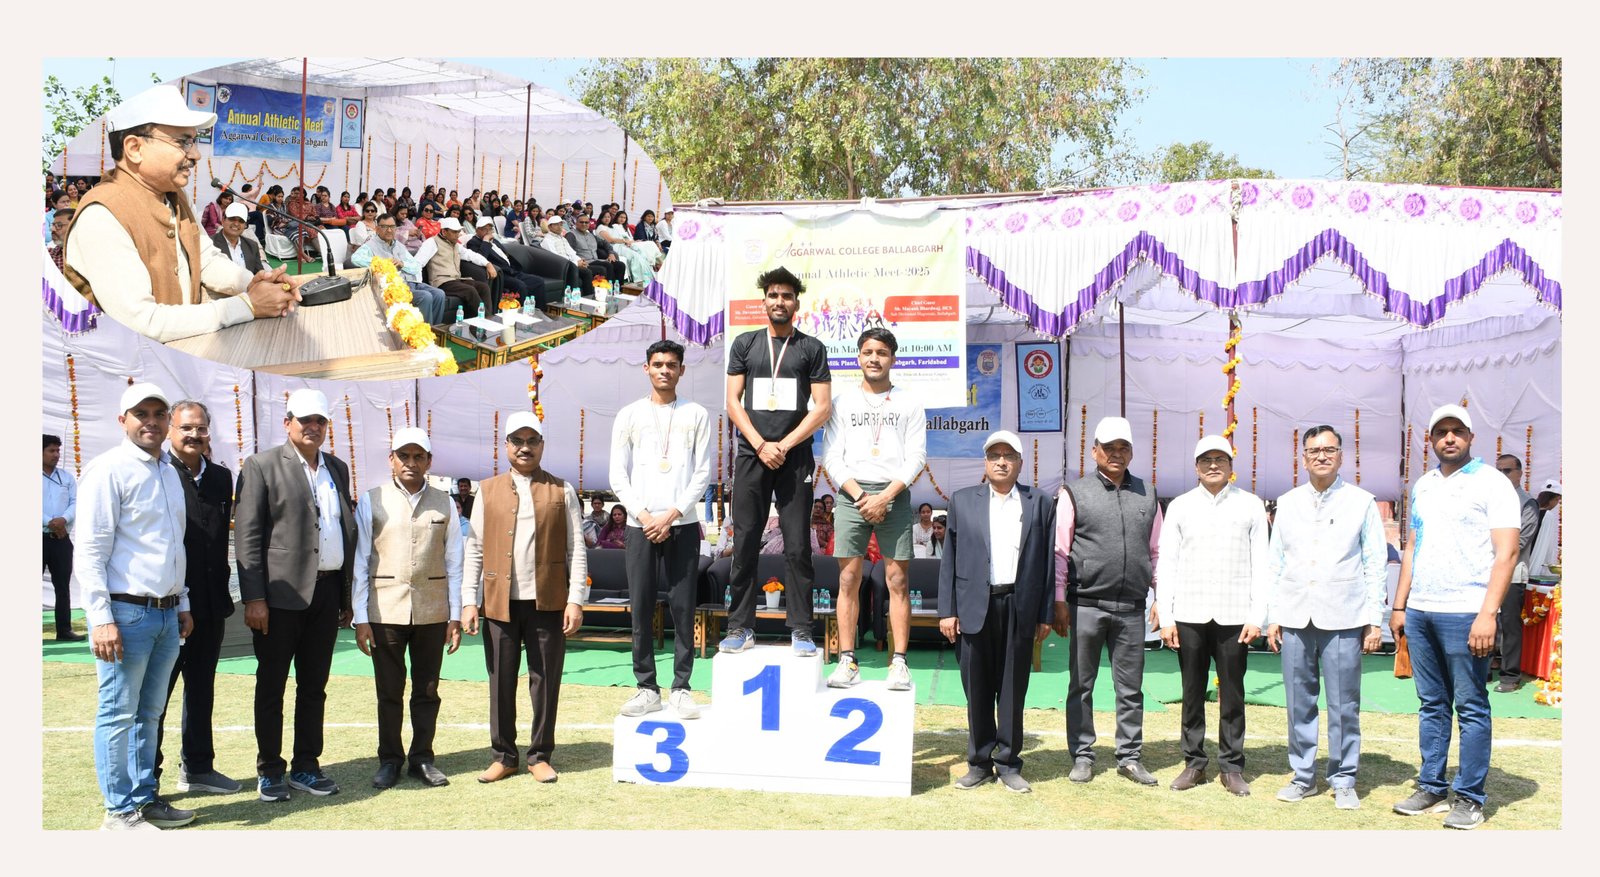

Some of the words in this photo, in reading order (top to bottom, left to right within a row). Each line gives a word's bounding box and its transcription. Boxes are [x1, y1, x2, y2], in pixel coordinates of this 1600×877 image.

[227, 109, 261, 126] Annual
[263, 112, 300, 131] Athletic
[221, 130, 259, 142] Aggarwal
[260, 132, 290, 145] College
[291, 136, 328, 148] Baabgarh
[775, 242, 836, 258] AGGARWAL
[839, 246, 880, 255] COLLEGE
[882, 245, 944, 254] BALLABGARH
[825, 268, 870, 280] Athletic
[874, 267, 931, 278] Meet-2025
[841, 345, 858, 353] Mar
[911, 344, 934, 353] 10:00
[936, 344, 952, 352] AM
[926, 416, 990, 434] allabgarh
[743, 664, 781, 731] 1
[824, 697, 884, 766] 2
[635, 720, 690, 782] 3
